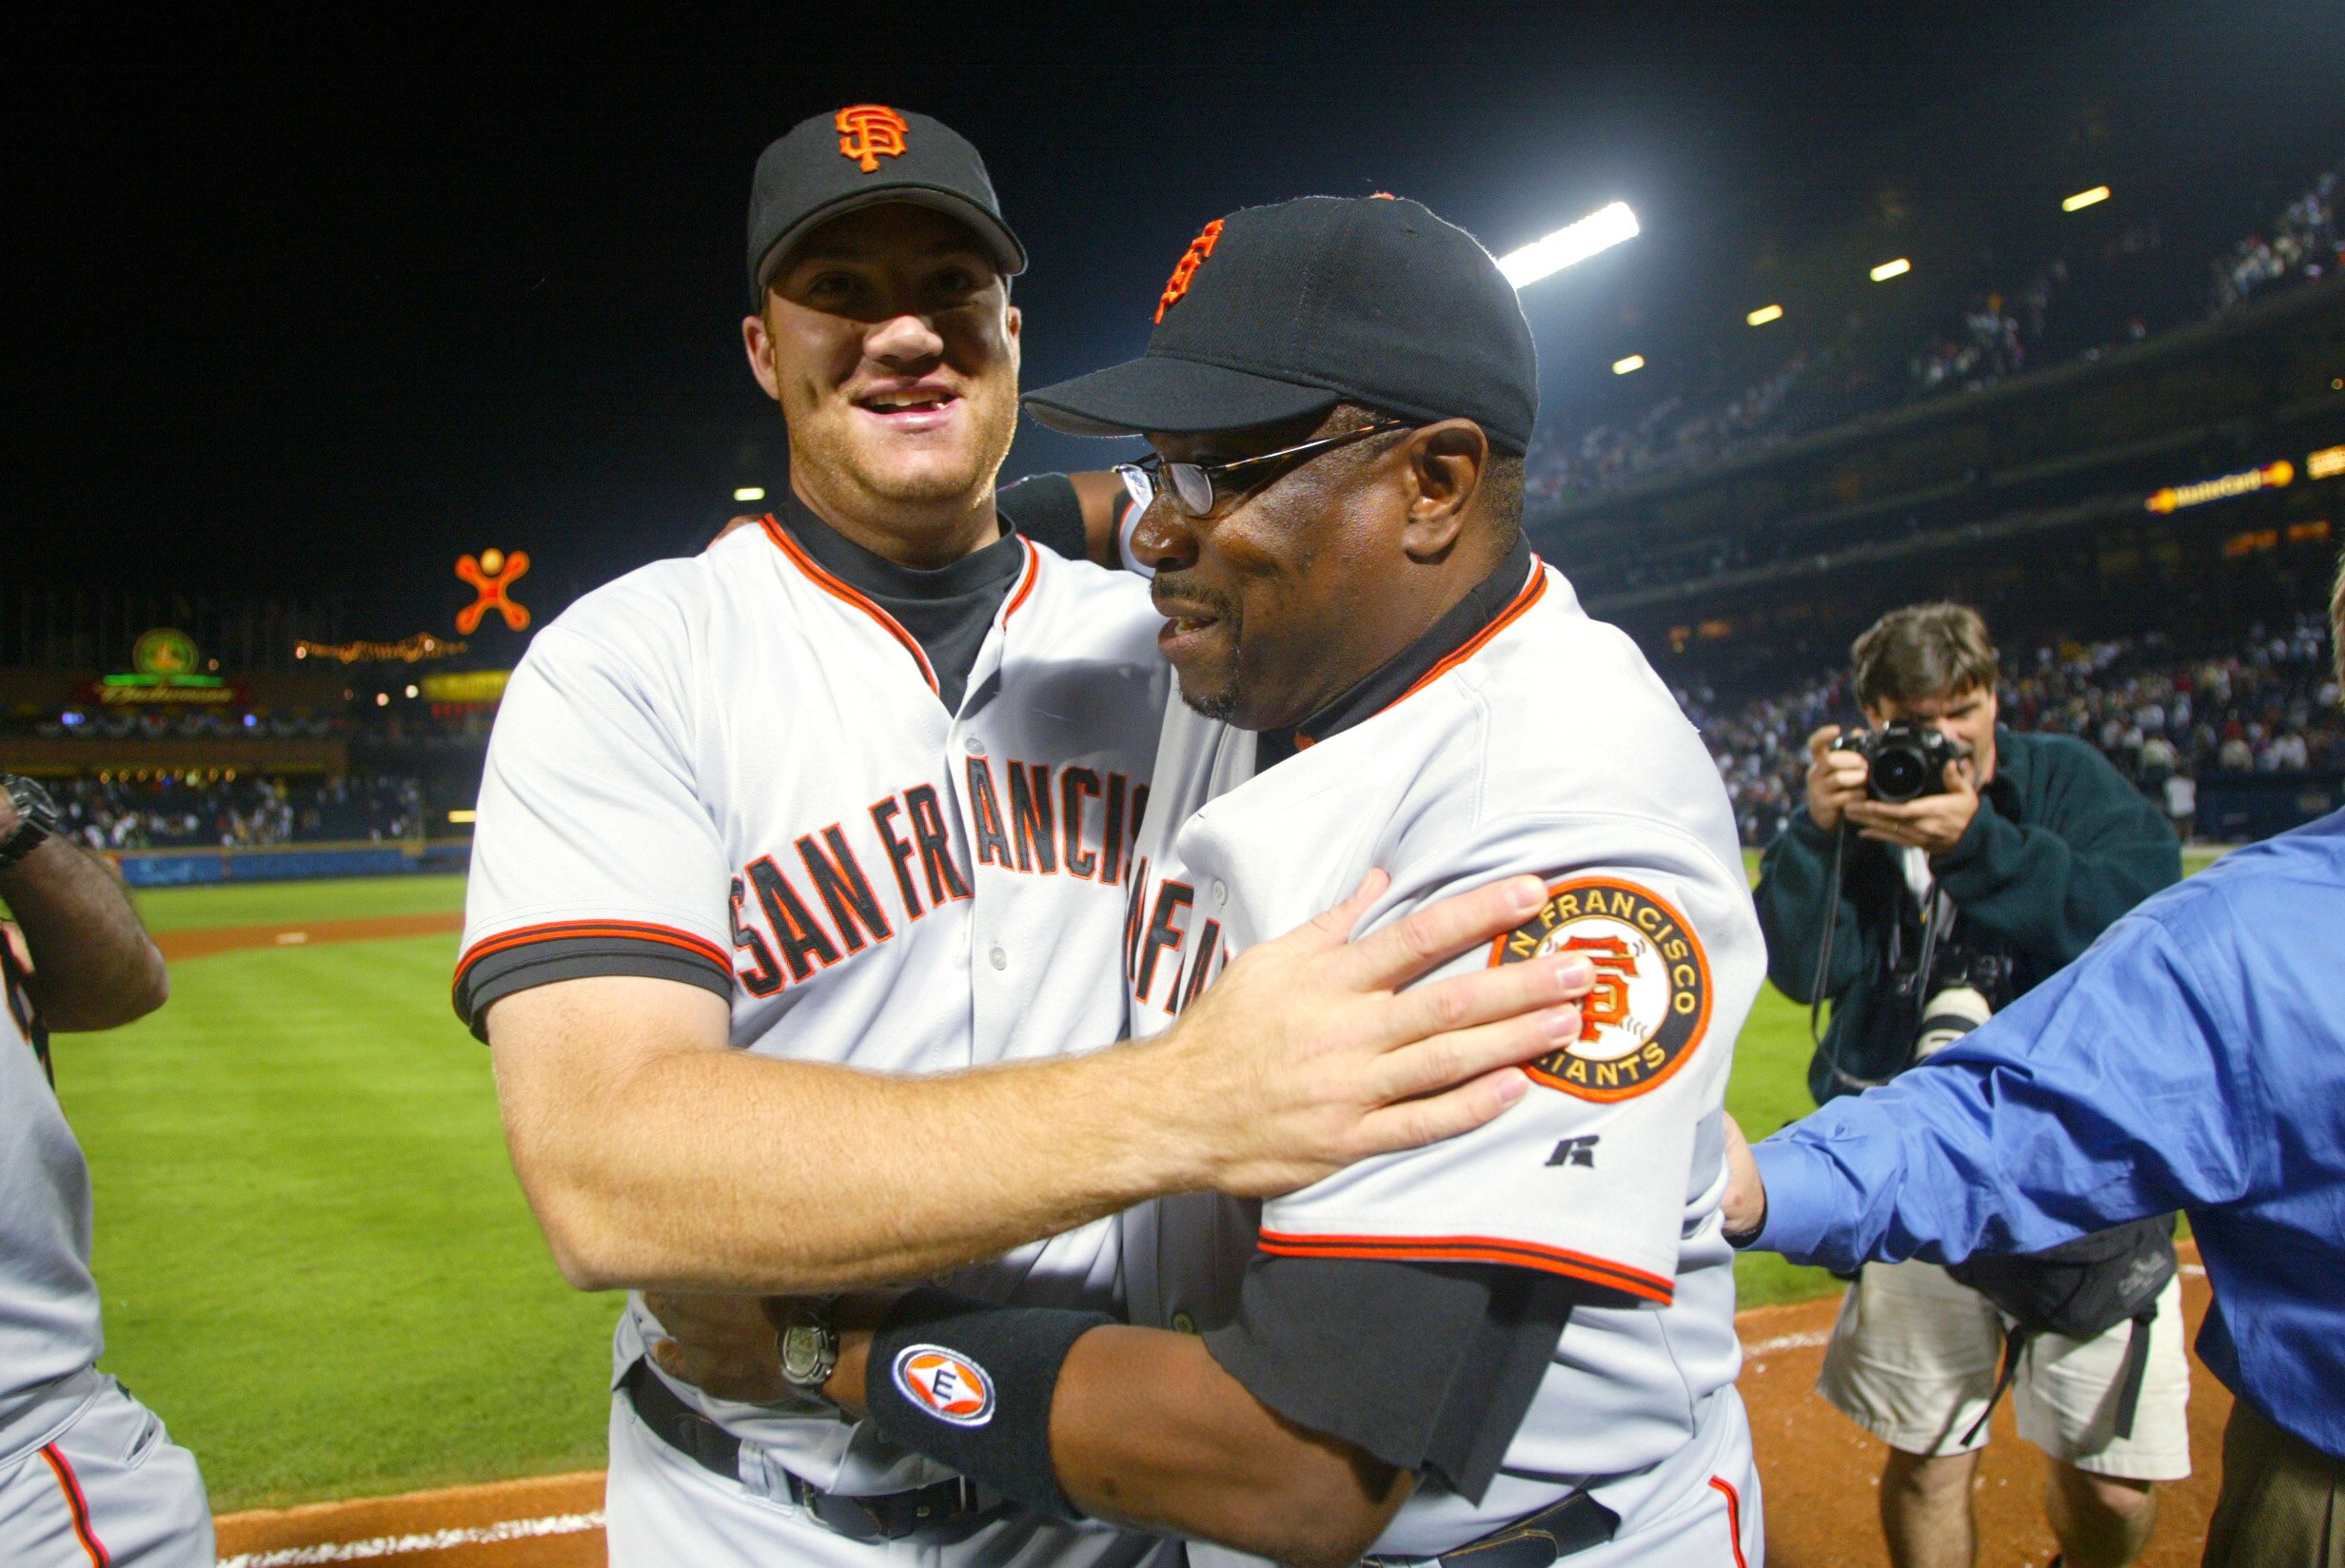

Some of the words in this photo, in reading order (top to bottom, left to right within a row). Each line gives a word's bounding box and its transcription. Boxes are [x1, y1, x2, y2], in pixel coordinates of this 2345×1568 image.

[835, 104, 909, 173] SF
[730, 822, 895, 999] SAN
[1536, 889, 1697, 1015] FRANCISCO
[1539, 1042, 1666, 1087] IANTS
[932, 1368, 957, 1401] E
